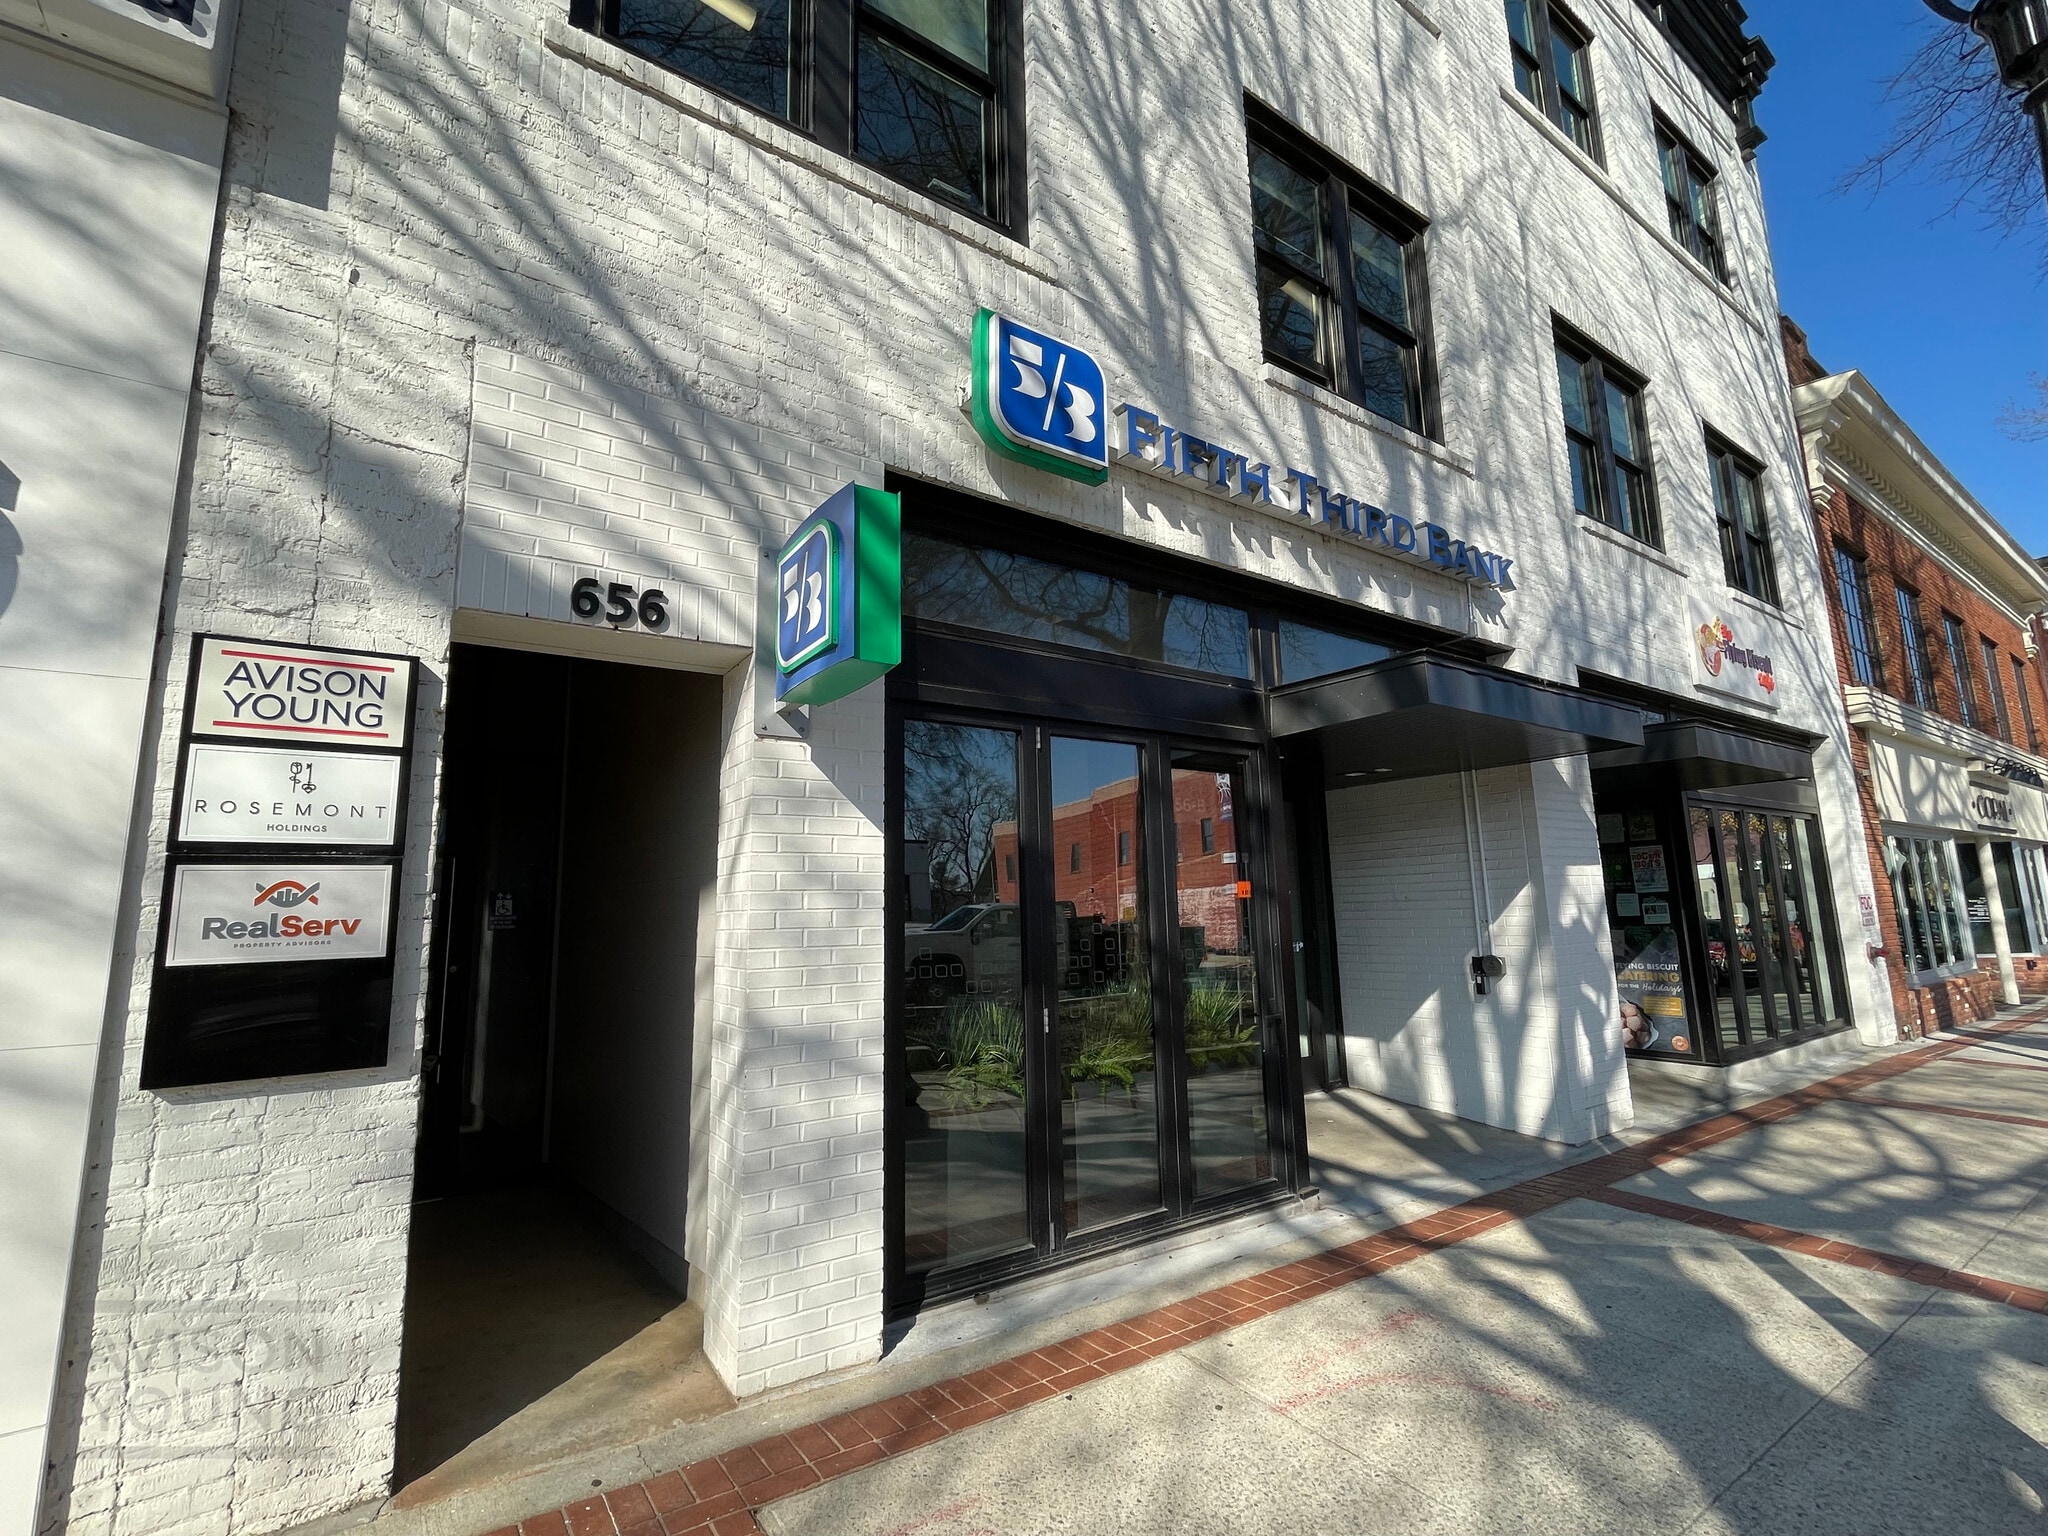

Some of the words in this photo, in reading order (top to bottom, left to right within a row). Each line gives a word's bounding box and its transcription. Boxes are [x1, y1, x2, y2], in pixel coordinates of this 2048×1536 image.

[1420, 520, 1517, 593] BANK
[570, 577, 667, 629] 656
[223, 660, 387, 700] AVISON
[222, 690, 384, 729] YOUNG
[194, 799, 387, 819] ROSEMONT
[266, 823, 328, 833] HOLDINGS
[201, 912, 362, 940] RealServ
[1646, 963, 1679, 971] BISCUIT
[1642, 982, 1683, 996] Holidays
